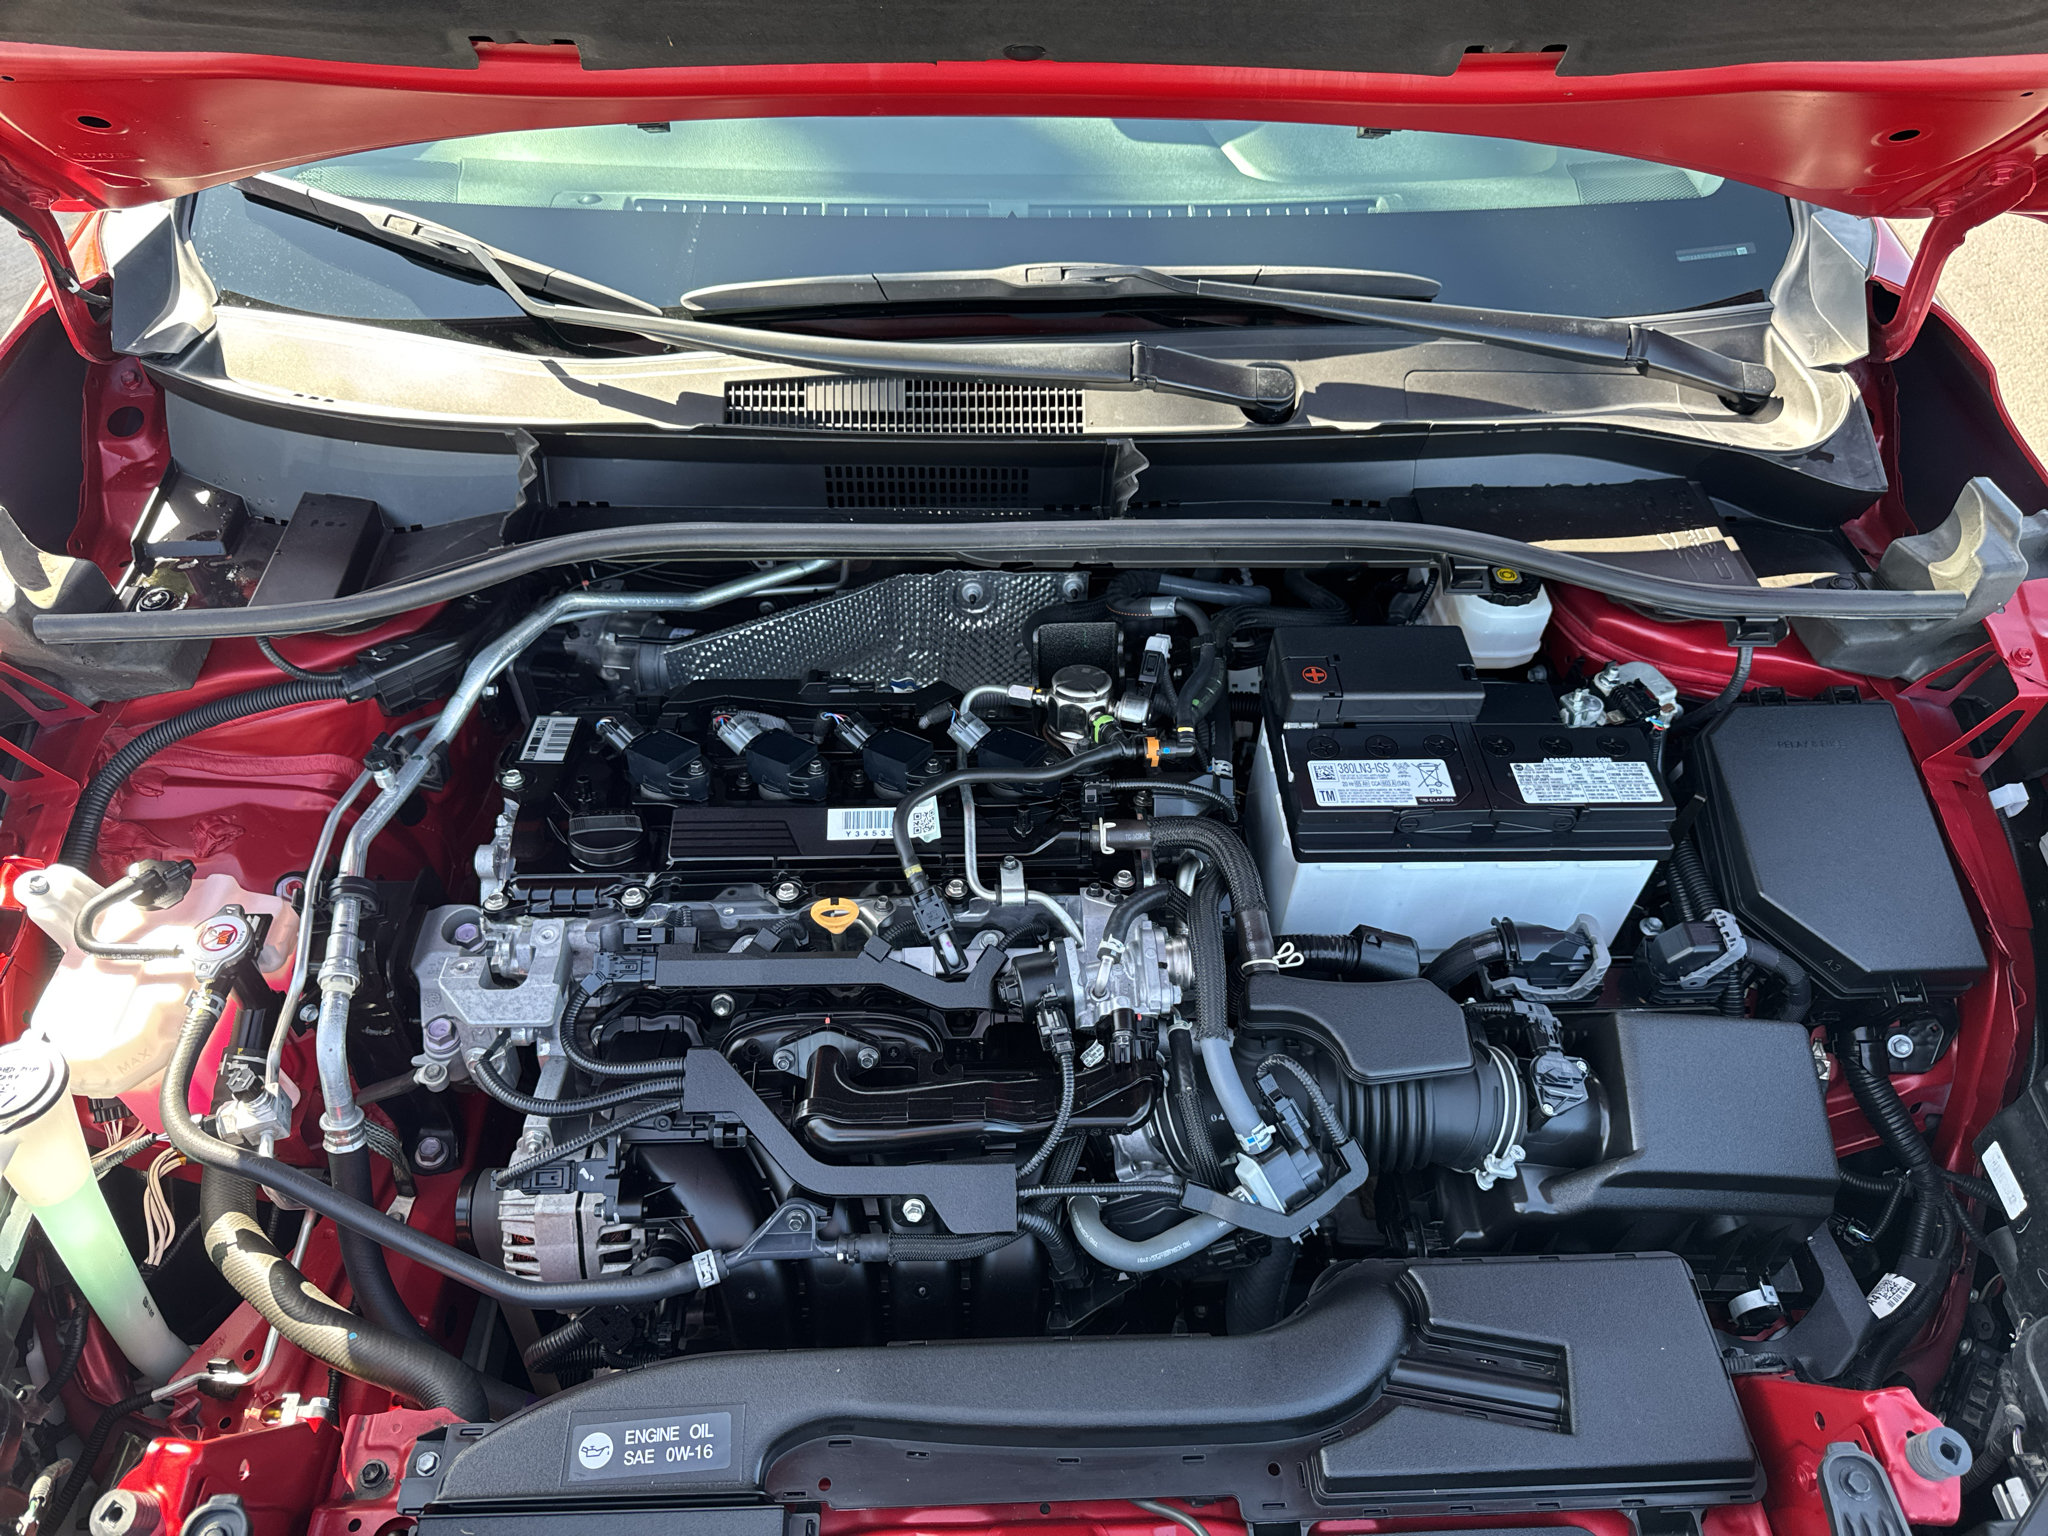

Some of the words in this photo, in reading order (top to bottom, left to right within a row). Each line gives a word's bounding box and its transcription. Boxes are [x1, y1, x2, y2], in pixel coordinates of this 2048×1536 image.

[1337, 762, 1390, 773] 380LN3-ISS
[1319, 790, 1336, 802] TM
[1823, 959, 1842, 972] A3
[116, 1048, 151, 1074] MAX
[624, 1426, 680, 1445] ENGINE
[689, 1423, 714, 1440] OIL
[623, 1449, 655, 1466] SAE
[666, 1444, 713, 1462] 0W-16
